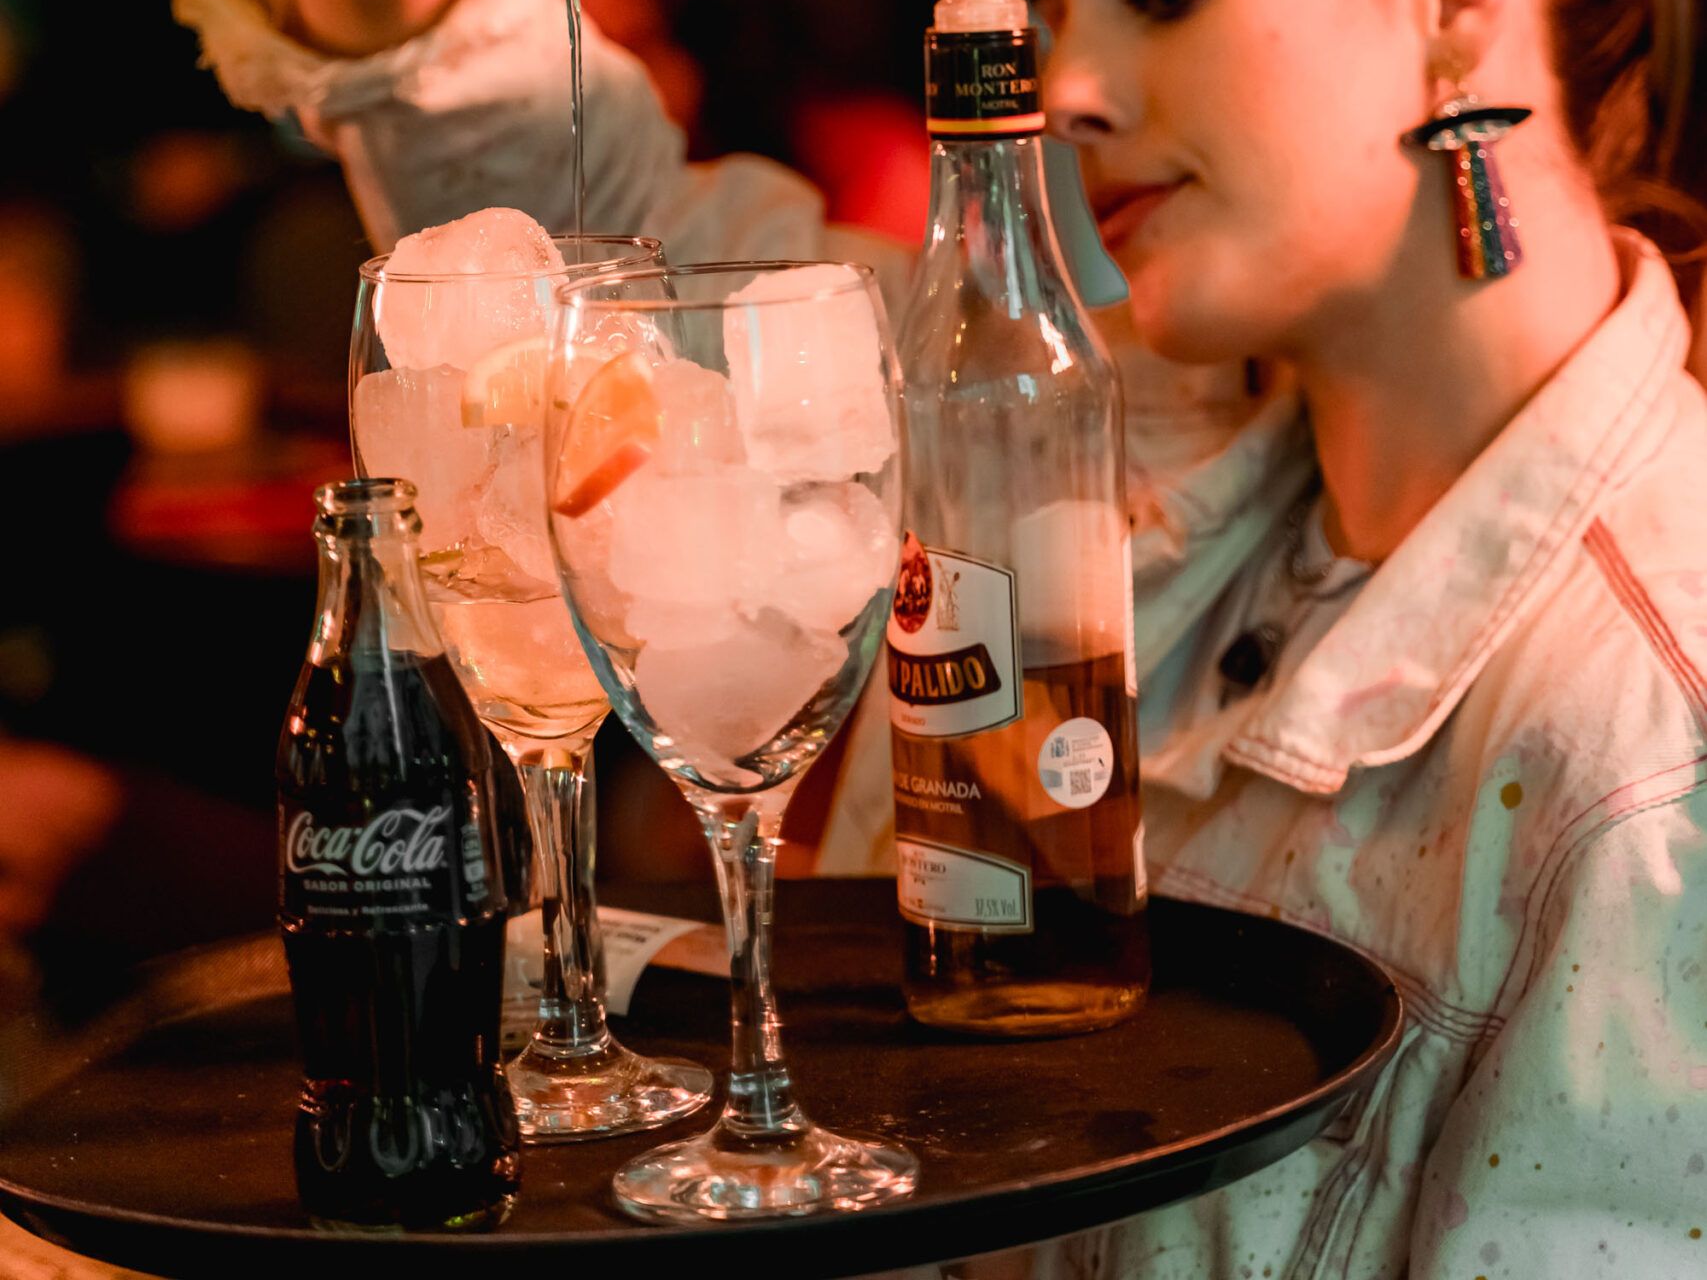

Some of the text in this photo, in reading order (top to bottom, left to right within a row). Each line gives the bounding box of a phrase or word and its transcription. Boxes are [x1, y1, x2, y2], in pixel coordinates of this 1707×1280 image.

[981, 63, 1016, 78] RON
[901, 656, 985, 697] PALIDO
[911, 776, 981, 799] GRANADA
[287, 805, 451, 876] Coca-Cola
[303, 877, 431, 892] SABOR ORIGINAL
